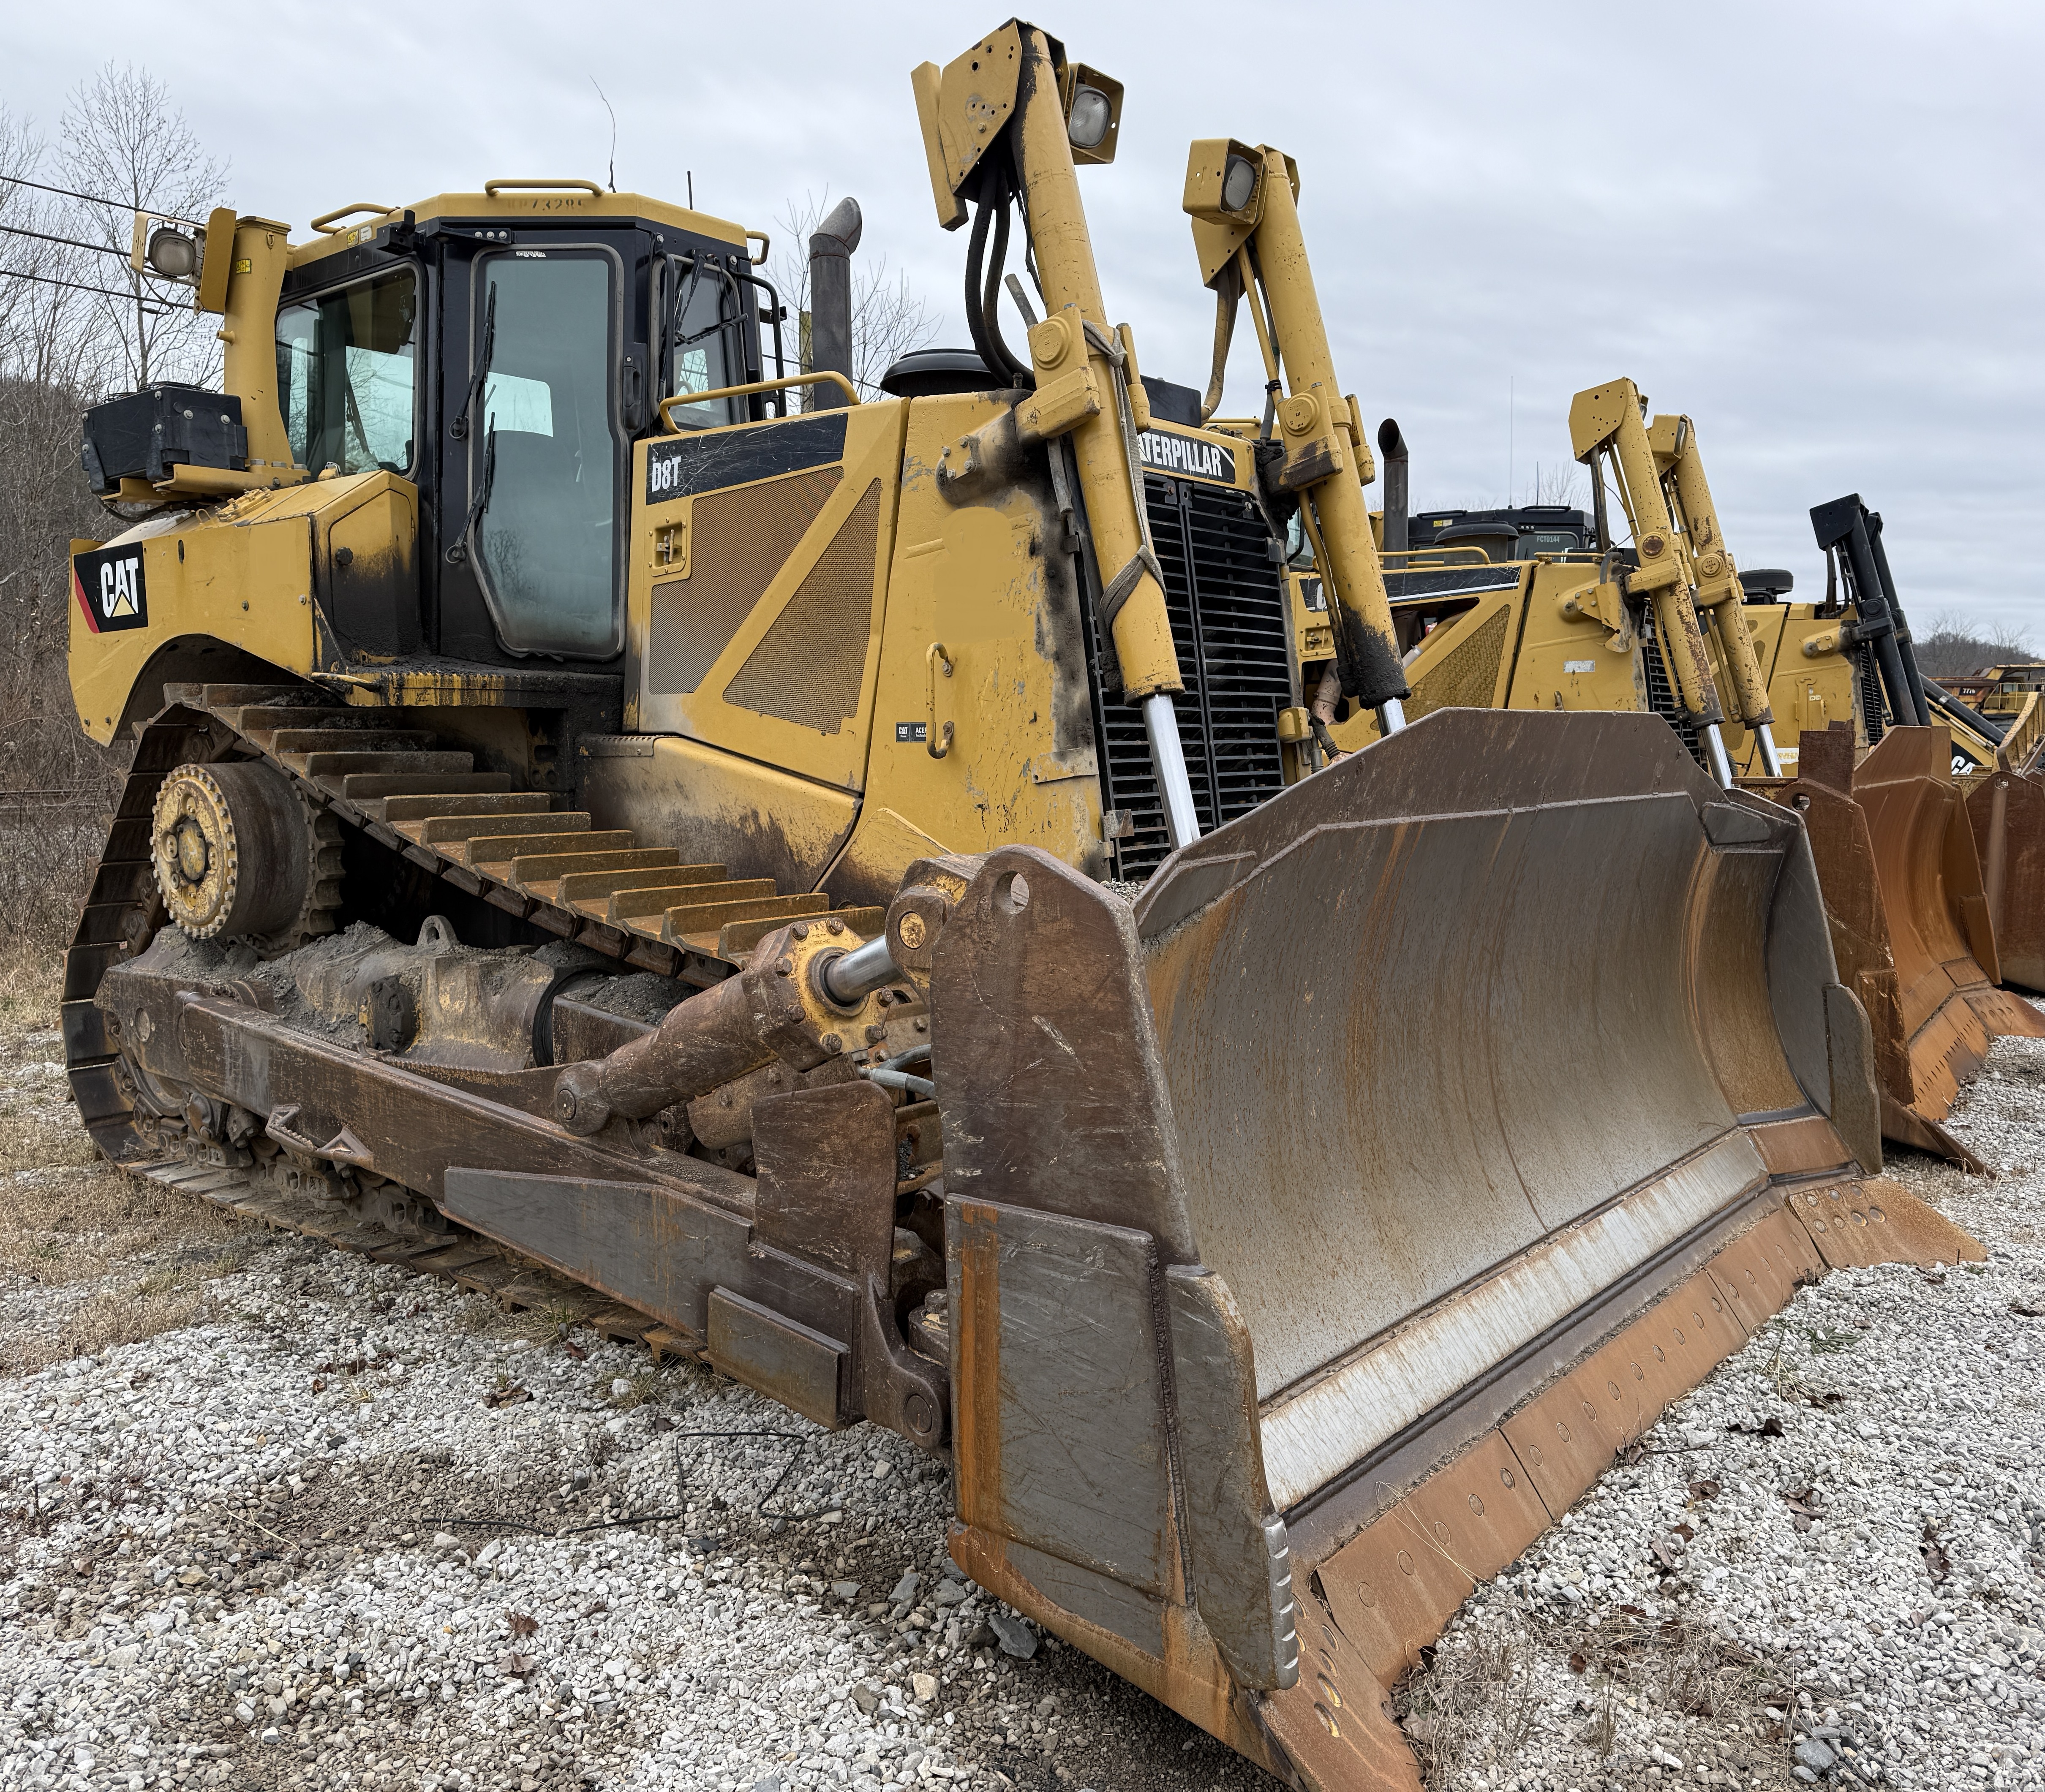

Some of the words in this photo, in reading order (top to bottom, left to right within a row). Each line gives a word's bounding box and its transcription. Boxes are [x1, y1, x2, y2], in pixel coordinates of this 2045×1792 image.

[651, 456, 681, 492] D8T
[100, 557, 139, 618] CAT
[899, 726, 908, 734] CAT
[1951, 756, 1976, 775] CA
